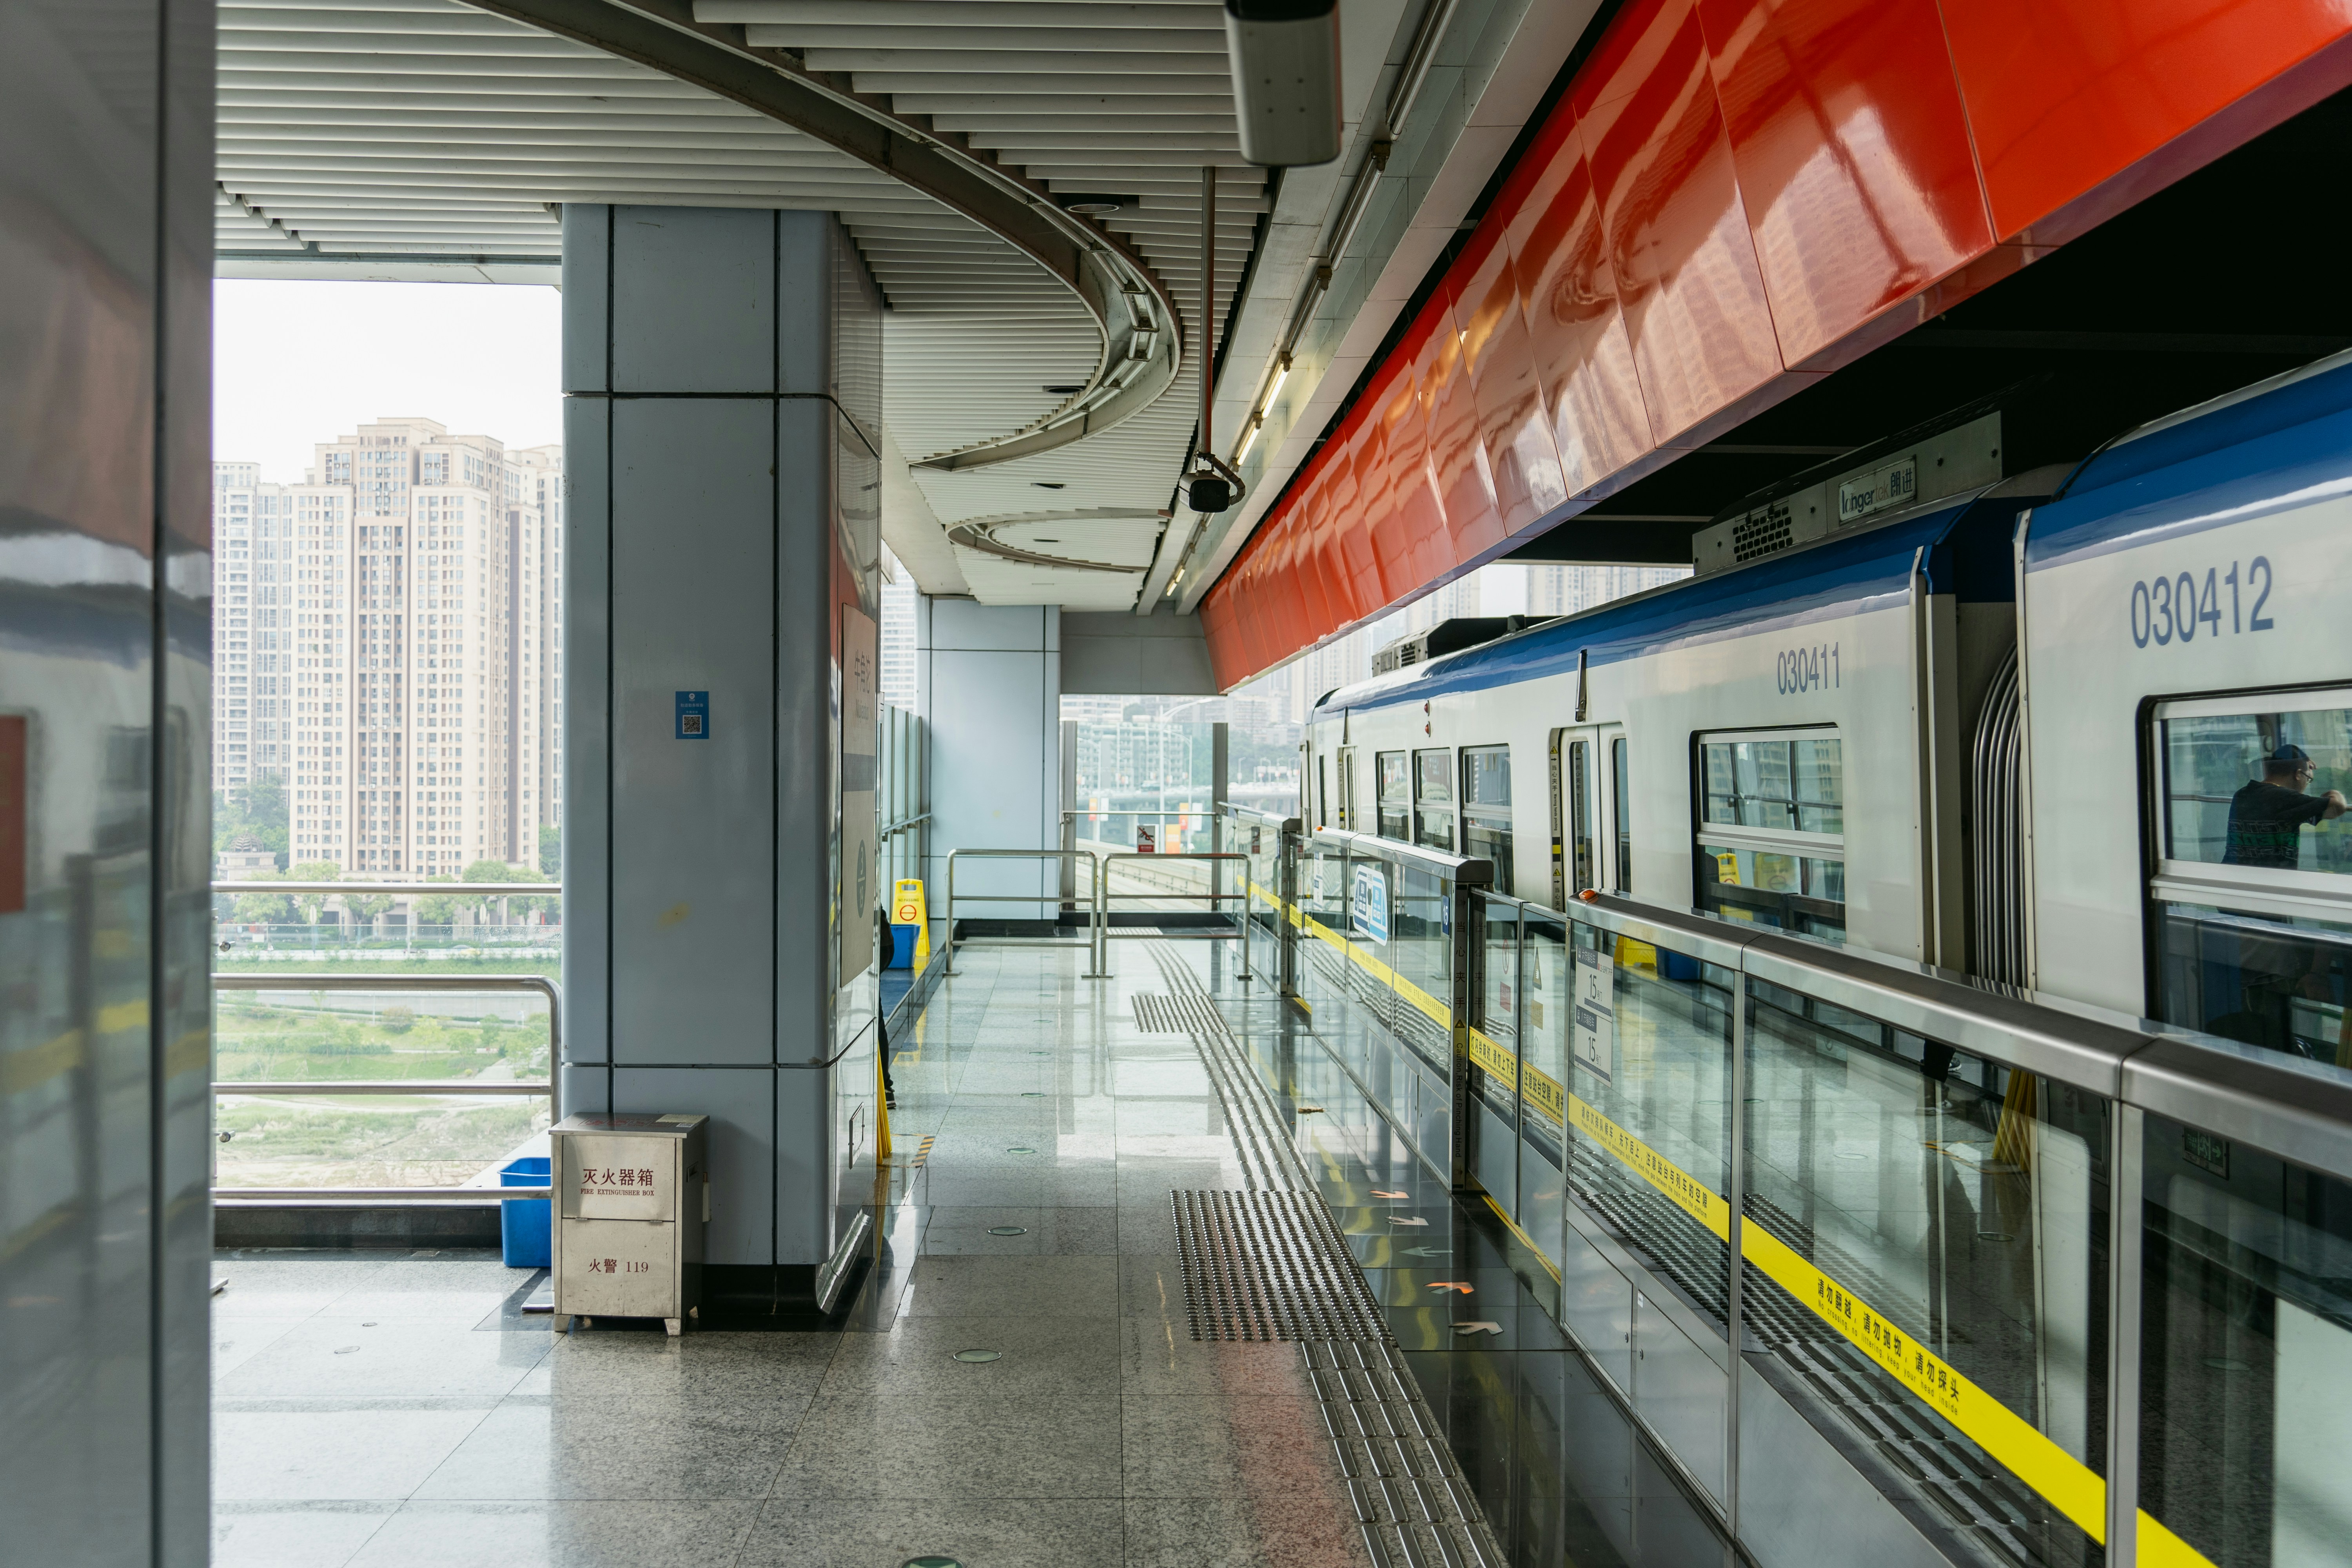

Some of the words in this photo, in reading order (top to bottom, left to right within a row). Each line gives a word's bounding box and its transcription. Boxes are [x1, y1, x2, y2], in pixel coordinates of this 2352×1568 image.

[2131, 555, 2274, 649] 030412
[855, 649, 871, 694] 牛角沱
[1777, 642, 1840, 695] 030411
[860, 847, 864, 875] 3
[1443, 905, 1448, 926] 15
[1455, 922, 1465, 1009] 当心夹手
[1582, 949, 1595, 964] 六节编组车
[1581, 1012, 1595, 1028] 八节编组车
[1454, 1103, 1463, 1135] Pinching
[582, 1168, 653, 1186] 灭火器箱
[1612, 1144, 1624, 1156] passengers
[1657, 1175, 1667, 1188] between
[1695, 1205, 1707, 1218] platform
[588, 1258, 617, 1274] 火警
[626, 1261, 649, 1273] 119
[1818, 1277, 1959, 1402] 请勿翻越，请勿抛物，请勿探头
[1818, 1300, 1824, 1309] No
[1852, 1326, 1858, 1337] no
[1887, 1354, 1899, 1371] keep
[1904, 1368, 1916, 1383] your
[1921, 1377, 1934, 1397] head
[1939, 1395, 1958, 1416] inside
